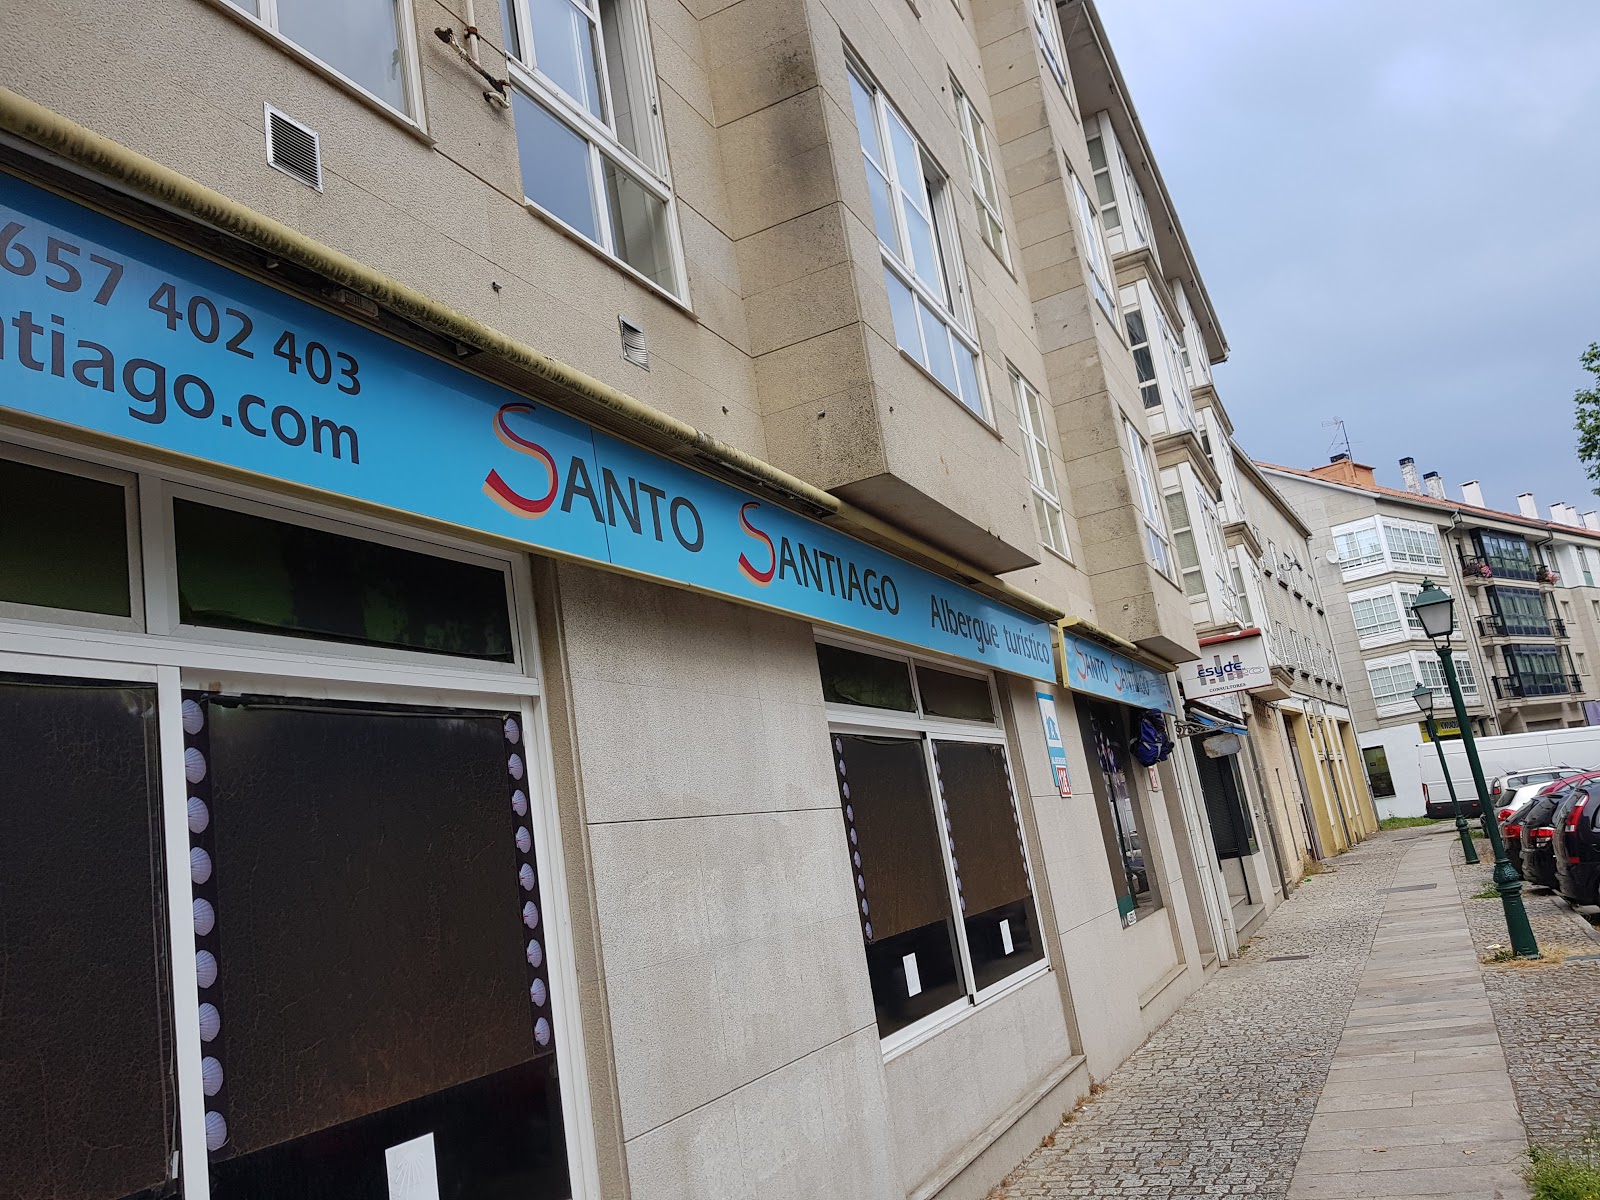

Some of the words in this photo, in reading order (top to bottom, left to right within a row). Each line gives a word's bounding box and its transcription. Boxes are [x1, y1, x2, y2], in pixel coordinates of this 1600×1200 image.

[0, 222, 124, 307] 657
[148, 282, 255, 359] 402
[273, 331, 362, 396] 403
[482, 402, 704, 552] SANTO
[738, 501, 899, 615] SANTIAGO
[930, 594, 1000, 654] Albergue
[1074, 637, 1109, 684] SANTO
[1196, 661, 1243, 678] esyde
